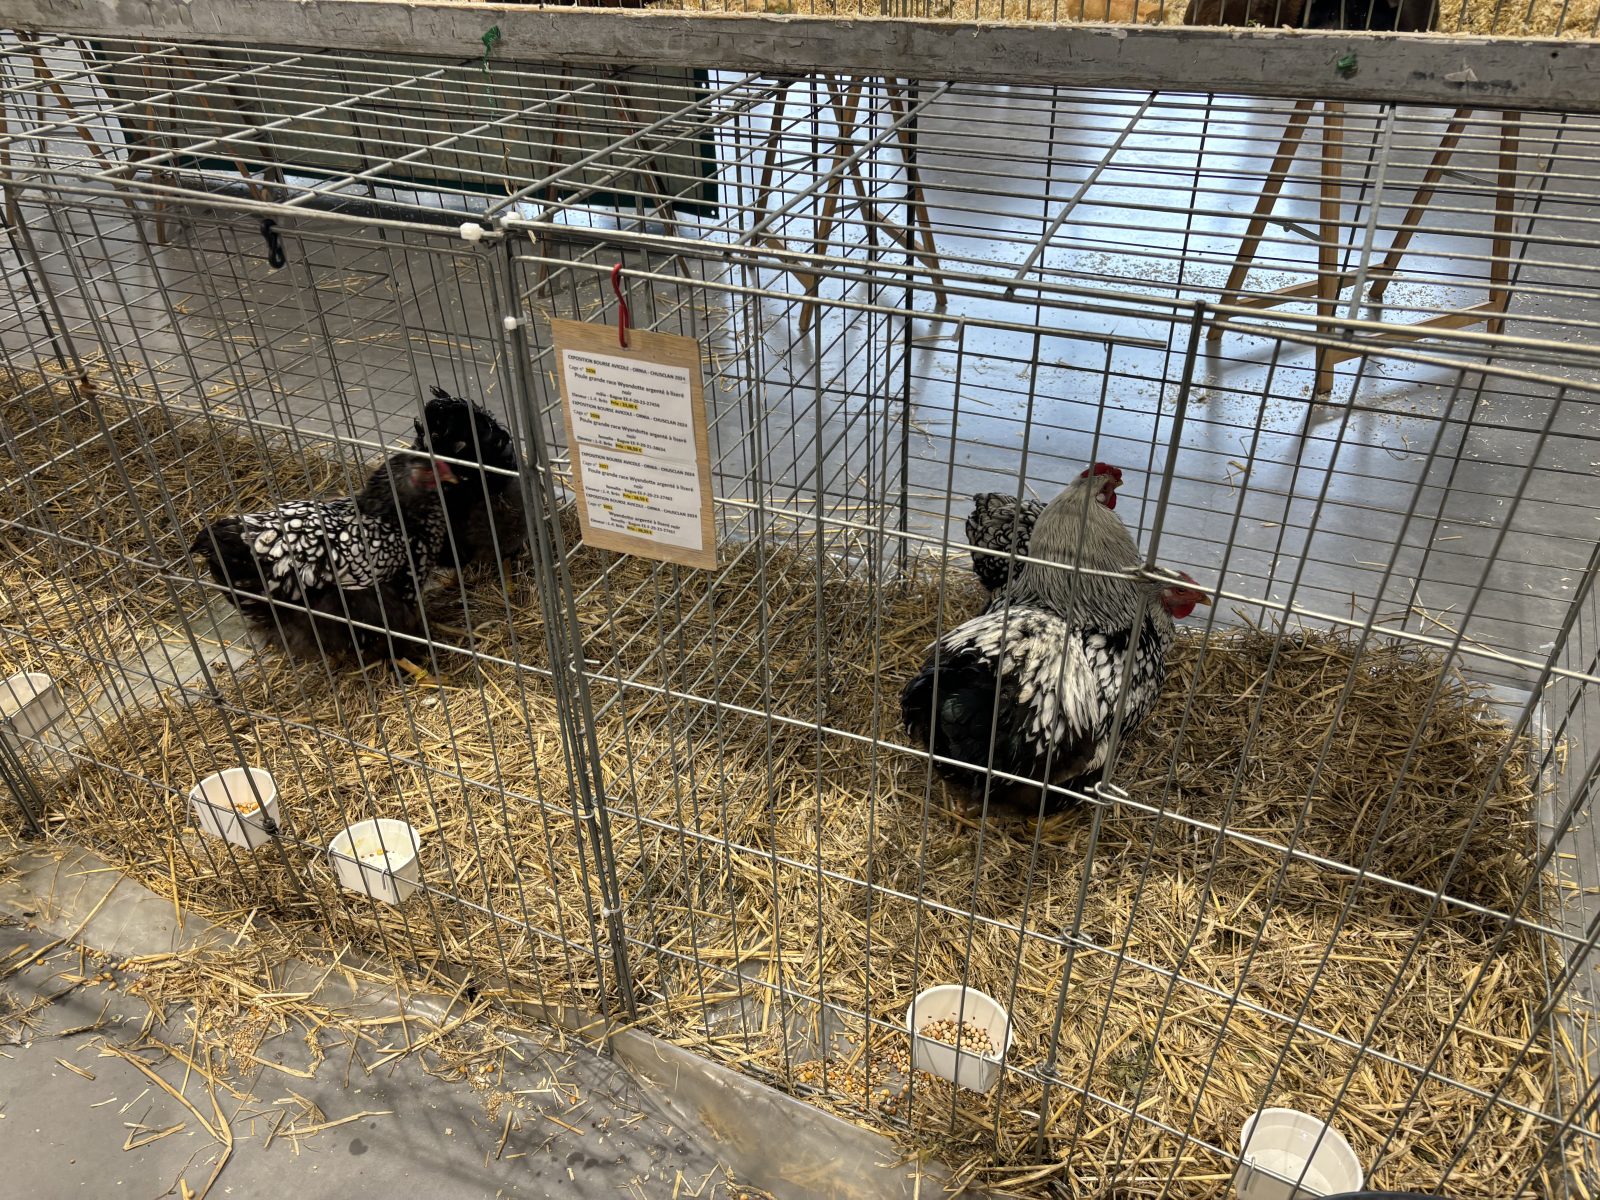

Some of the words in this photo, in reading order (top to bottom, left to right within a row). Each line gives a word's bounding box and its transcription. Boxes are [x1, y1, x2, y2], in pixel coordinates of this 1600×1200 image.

[568, 355, 593, 364] EXPOSITION
[611, 363, 629, 371] AVICOLE
[651, 370, 675, 380] CHUSCLAN
[589, 375, 605, 384] grande
[618, 381, 644, 391] Wyandotte
[646, 387, 665, 396] argenté
[572, 400, 596, 409] EXPOSITION
[594, 420, 609, 428] grande
[622, 426, 648, 436] Wyandotte
[650, 432, 668, 441] argenté
[582, 452, 606, 460] EXPOSITION
[630, 476, 656, 486] Wyandotte
[657, 481, 675, 490] argenté
[586, 493, 609, 502] EXPOSITION
[609, 511, 634, 521] Wyandotte
[635, 517, 652, 525] argenté
